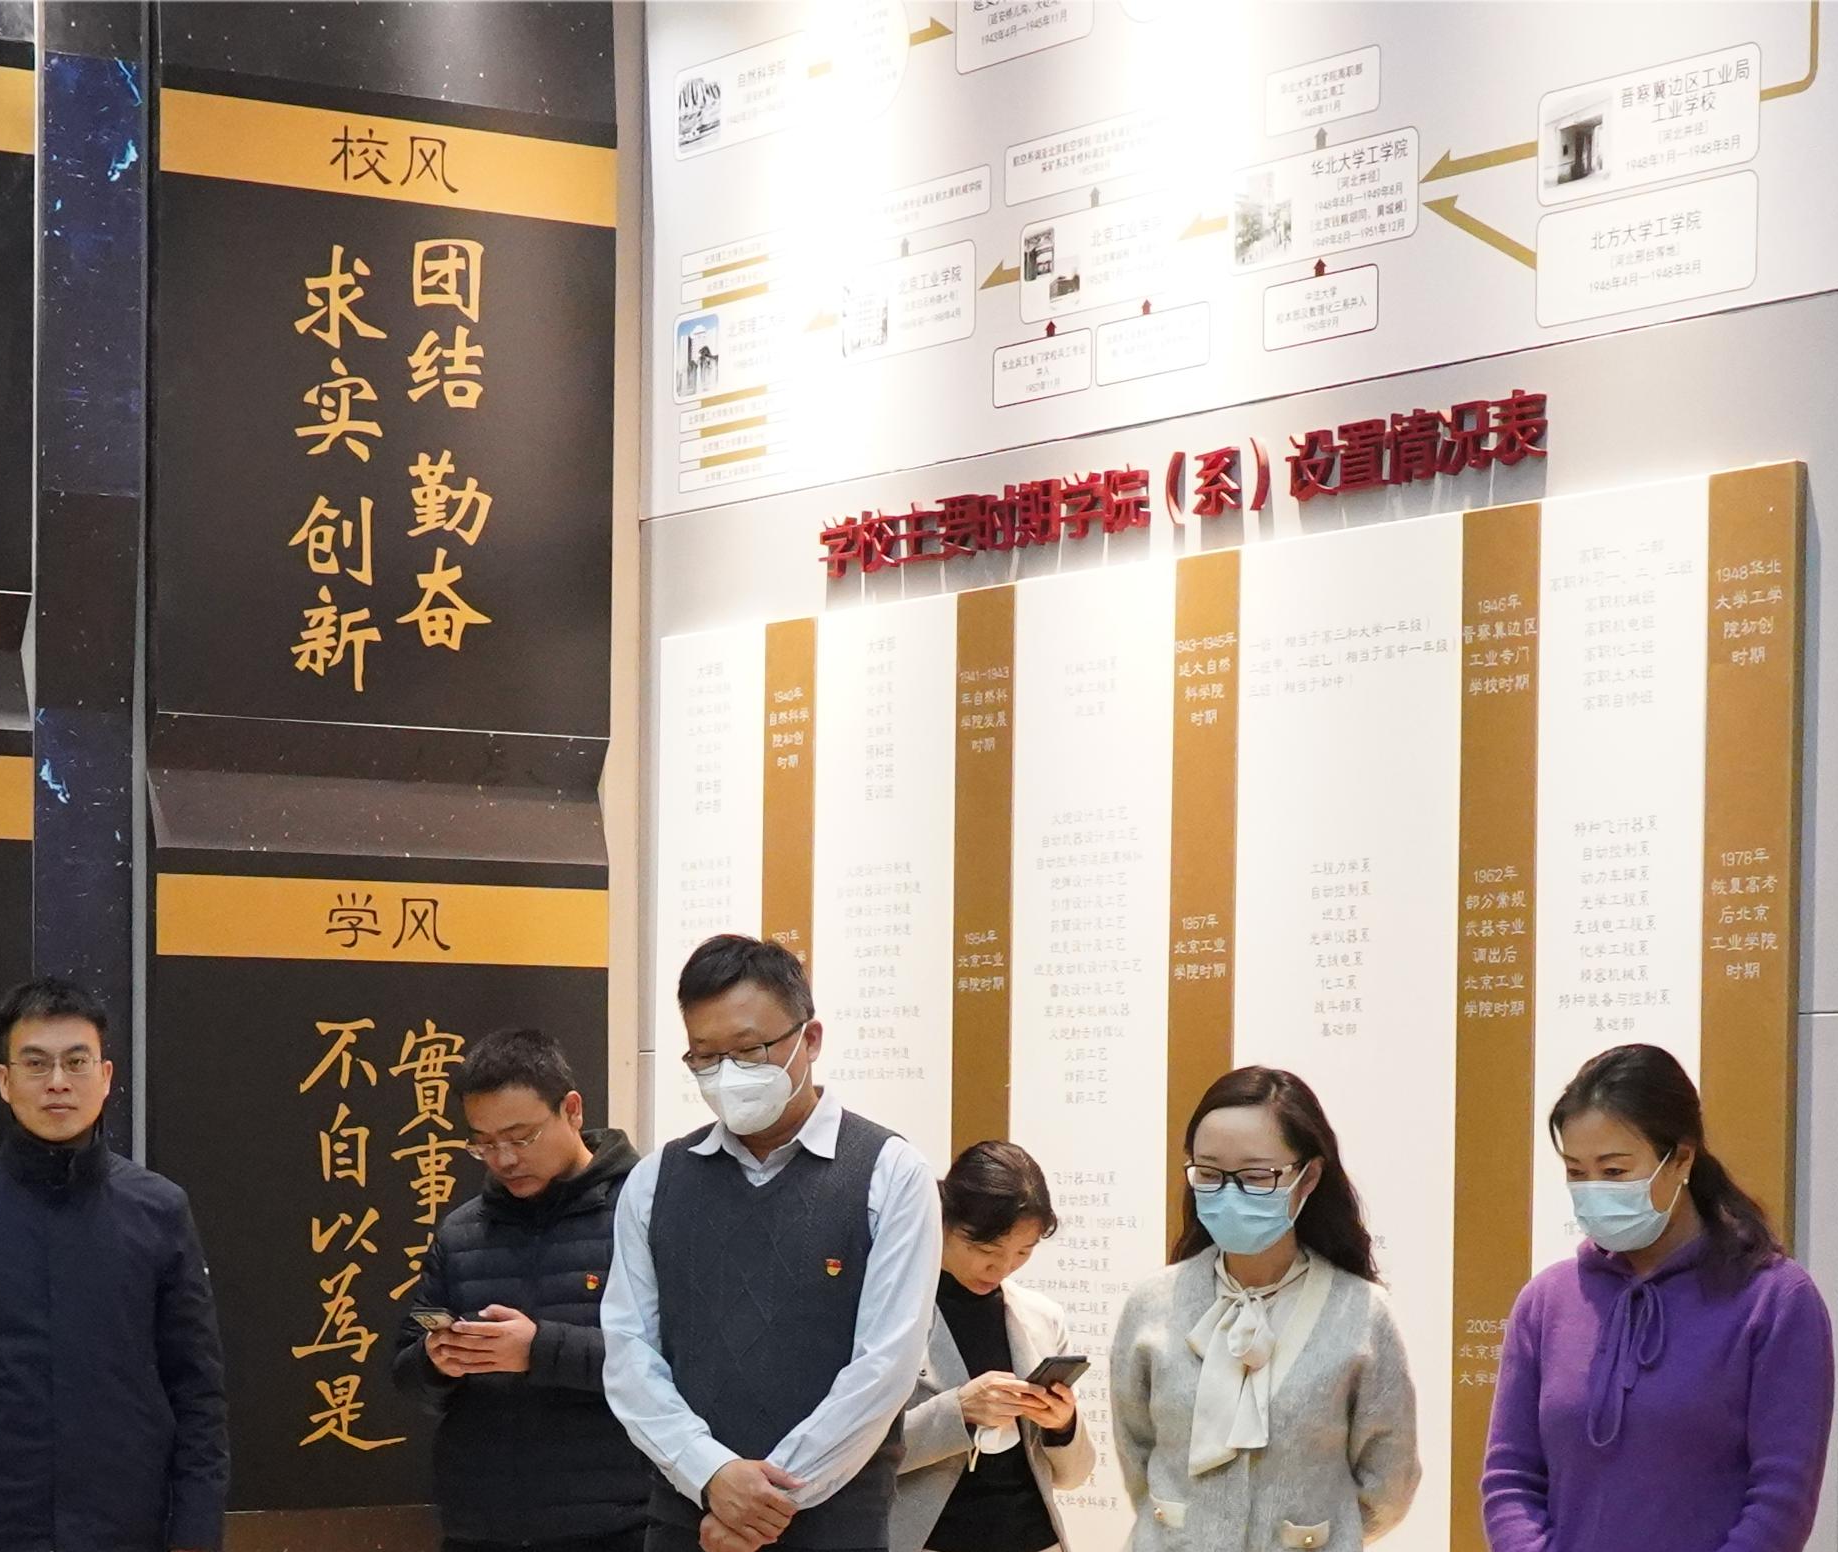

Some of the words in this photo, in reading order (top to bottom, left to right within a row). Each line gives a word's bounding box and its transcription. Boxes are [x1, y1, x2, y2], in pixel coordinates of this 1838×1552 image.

[1651, 90, 1717, 124] 工业学校
[328, 124, 459, 195] 校风
[1311, 137, 1410, 177] 华北大学工学院
[1590, 209, 1703, 252] 北方大学工学院
[406, 237, 486, 410] 团结
[292, 244, 389, 463] 求实
[395, 450, 494, 653] 勤奋
[1715, 558, 1783, 583] 1948华北
[287, 494, 383, 694] 创新
[1714, 586, 1783, 611] 大学工学
[1723, 615, 1775, 640] 院初创
[1468, 645, 1529, 668] 工业专门
[1731, 646, 1767, 667] 时期
[1184, 682, 1225, 703] 科学院
[1468, 672, 1530, 697] 学校时期
[1190, 708, 1219, 727] 时期
[1582, 839, 1651, 861] 自动控制系
[1720, 847, 1771, 868] 1978年
[1473, 864, 1519, 884] 1962年
[1710, 874, 1779, 897] 恢复高考
[1464, 889, 1527, 911] 部分常规
[324, 891, 452, 952] 学风
[1718, 903, 1771, 925] 后北京
[1464, 916, 1527, 938] 武器专业
[1173, 937, 1227, 955] 北京工业
[1579, 939, 1650, 959] 化学工程系
[1709, 931, 1779, 952] 工业学院
[957, 951, 1005, 969] 北京工业
[1725, 961, 1762, 981] 时期
[1173, 963, 1227, 982] 学院时期
[1320, 974, 1359, 991] 化工系
[1463, 972, 1526, 992] 北京工业
[957, 975, 1005, 993] 学院时期
[1463, 999, 1526, 1019] 学院时期
